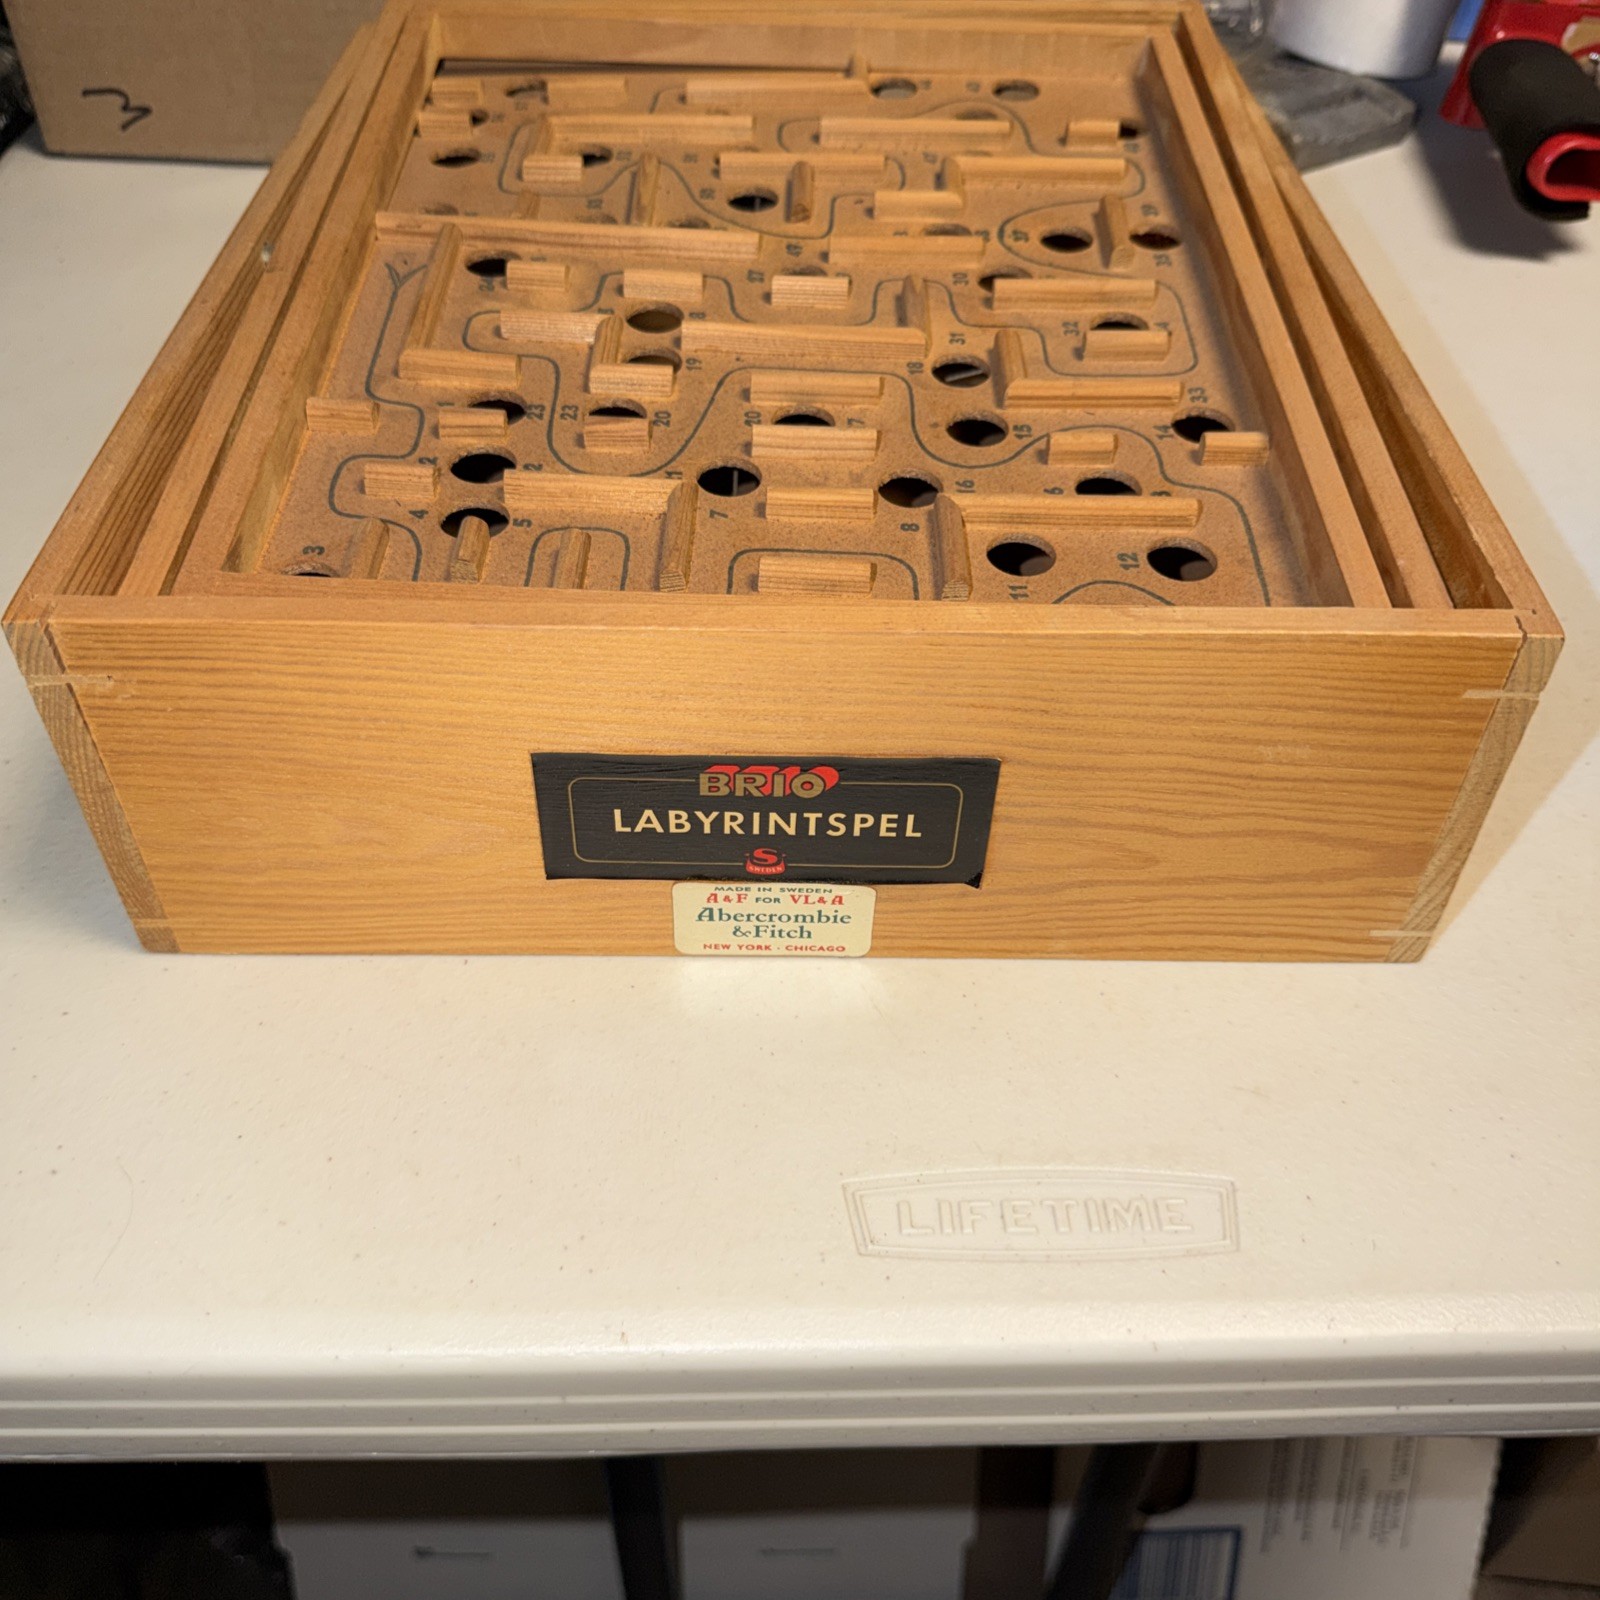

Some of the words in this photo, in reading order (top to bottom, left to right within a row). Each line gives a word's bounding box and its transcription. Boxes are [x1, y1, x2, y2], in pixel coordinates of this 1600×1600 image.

[1063, 321, 1080, 337] 32
[949, 333, 966, 345] 31
[685, 358, 704, 371] 19
[906, 361, 925, 374] 18
[1189, 387, 1209, 403] 33
[525, 403, 546, 421] 23
[560, 404, 579, 422] 23
[653, 410, 672, 428] 20
[1013, 425, 1033, 440] 15
[1152, 424, 1174, 440] 14
[955, 479, 976, 494] 16
[408, 508, 429, 520] 4
[709, 509, 729, 520] 7
[511, 518, 533, 529] 5
[900, 523, 920, 533] 8
[302, 545, 325, 556] 3
[1118, 552, 1140, 572] 12
[1008, 584, 1029, 600] 11
[699, 765, 839, 799] BRIO
[612, 808, 923, 839] LABYRINTSPEL
[778, 887, 834, 895] SWEDEN
[754, 896, 782, 904] FOR
[695, 907, 853, 925] Abercrombie
[732, 924, 814, 940] &Fitch
[703, 943, 731, 951] NEW
[785, 944, 847, 953] CHICAGO
[895, 1198, 1194, 1236] LIFETIME
